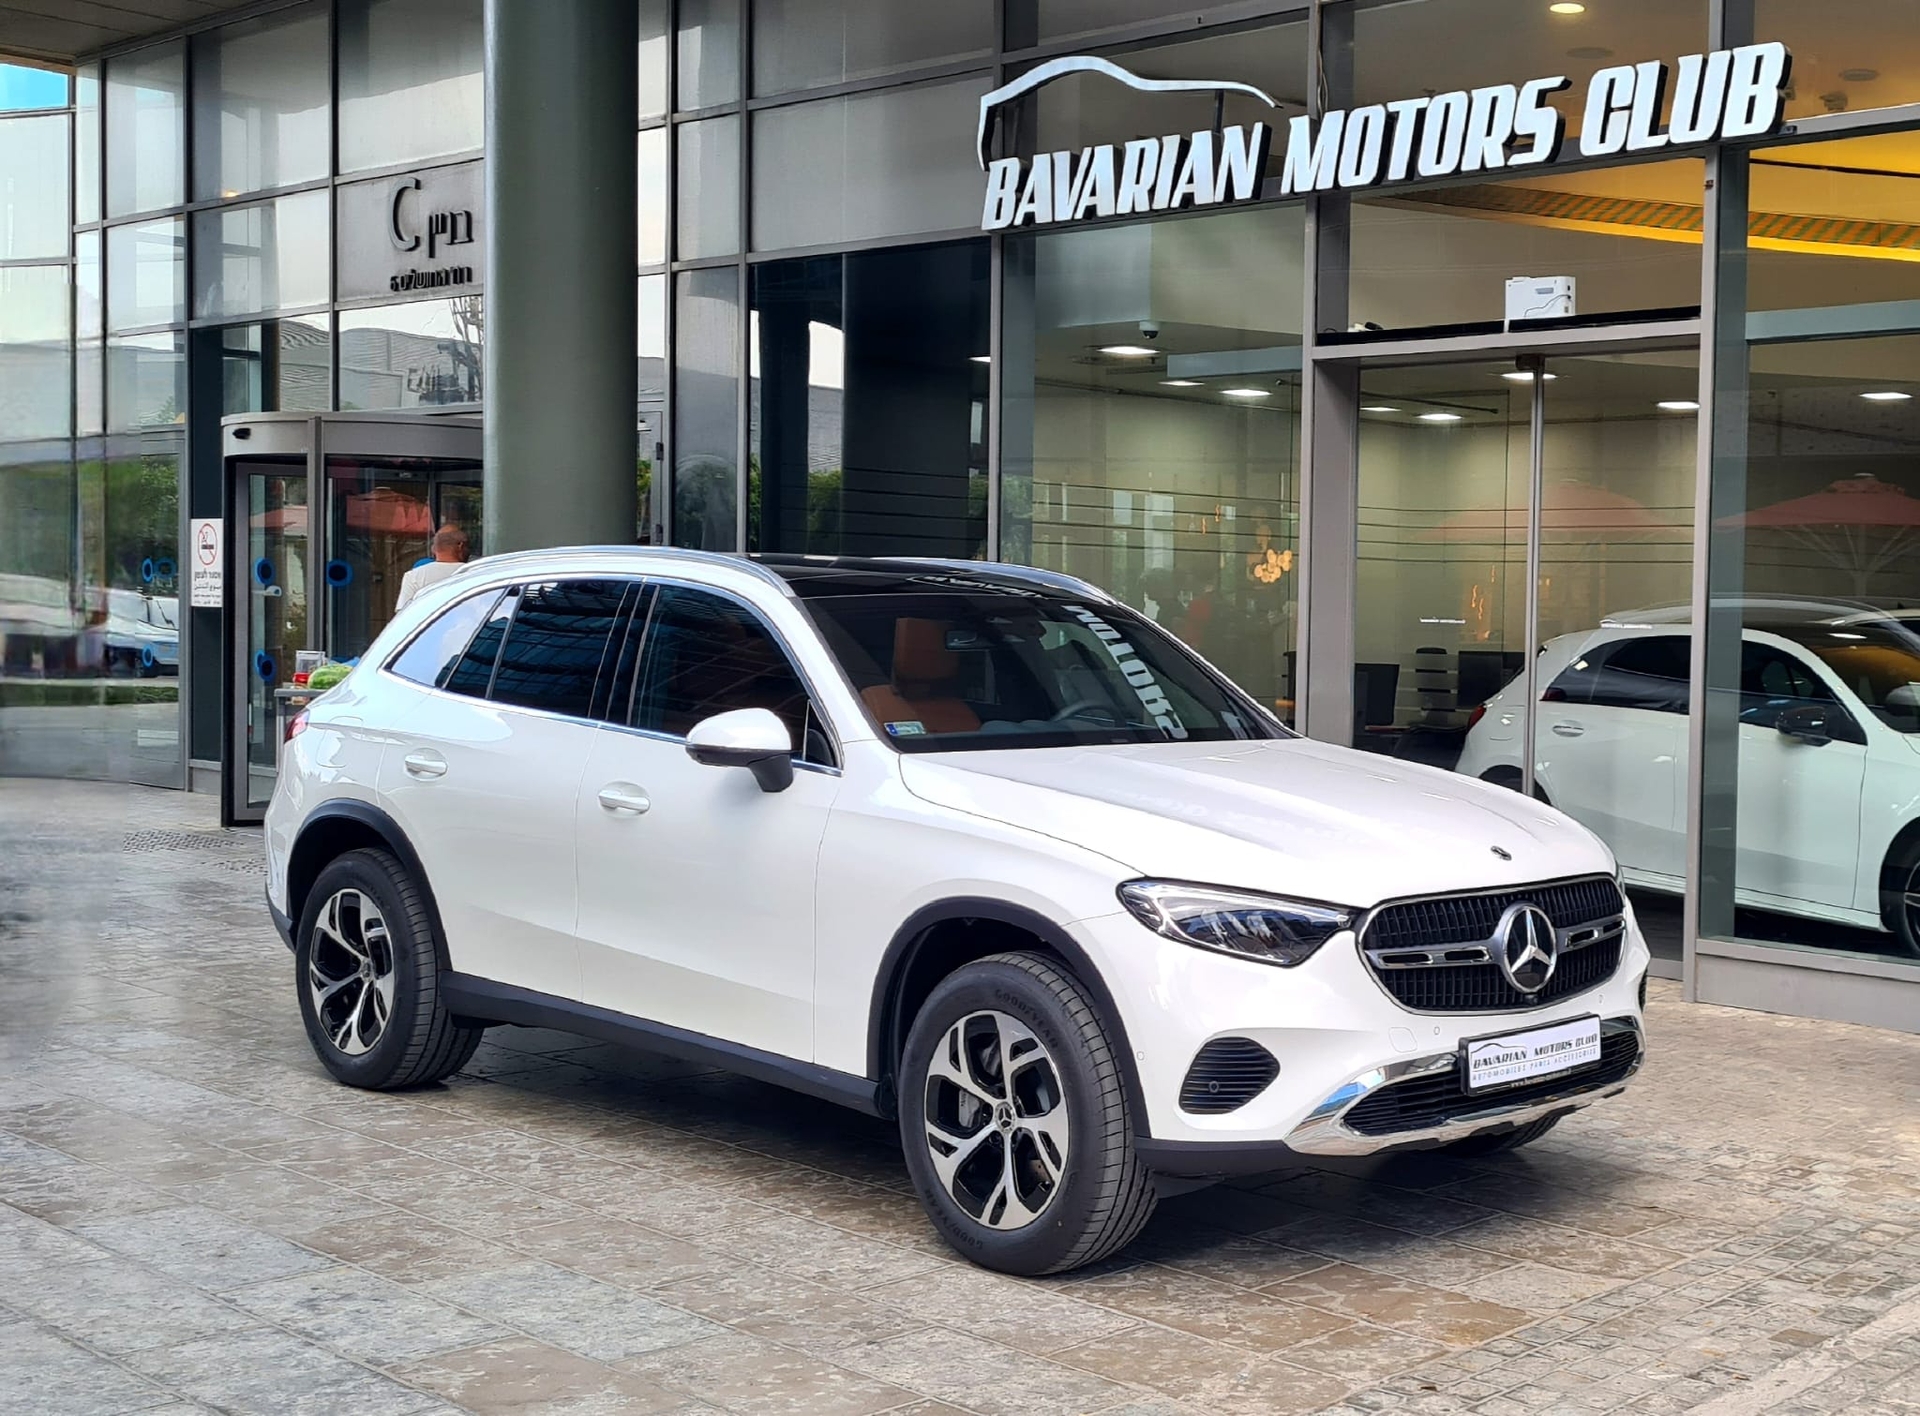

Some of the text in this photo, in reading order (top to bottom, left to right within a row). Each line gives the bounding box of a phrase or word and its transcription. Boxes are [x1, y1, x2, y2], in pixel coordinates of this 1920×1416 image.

[981, 42, 1792, 233] BAVARIAN MOTORS CLUB
[388, 176, 475, 259] בניין C
[1473, 1050, 1528, 1070] BAVARIAN
[1534, 1040, 1574, 1057] MOTORS
